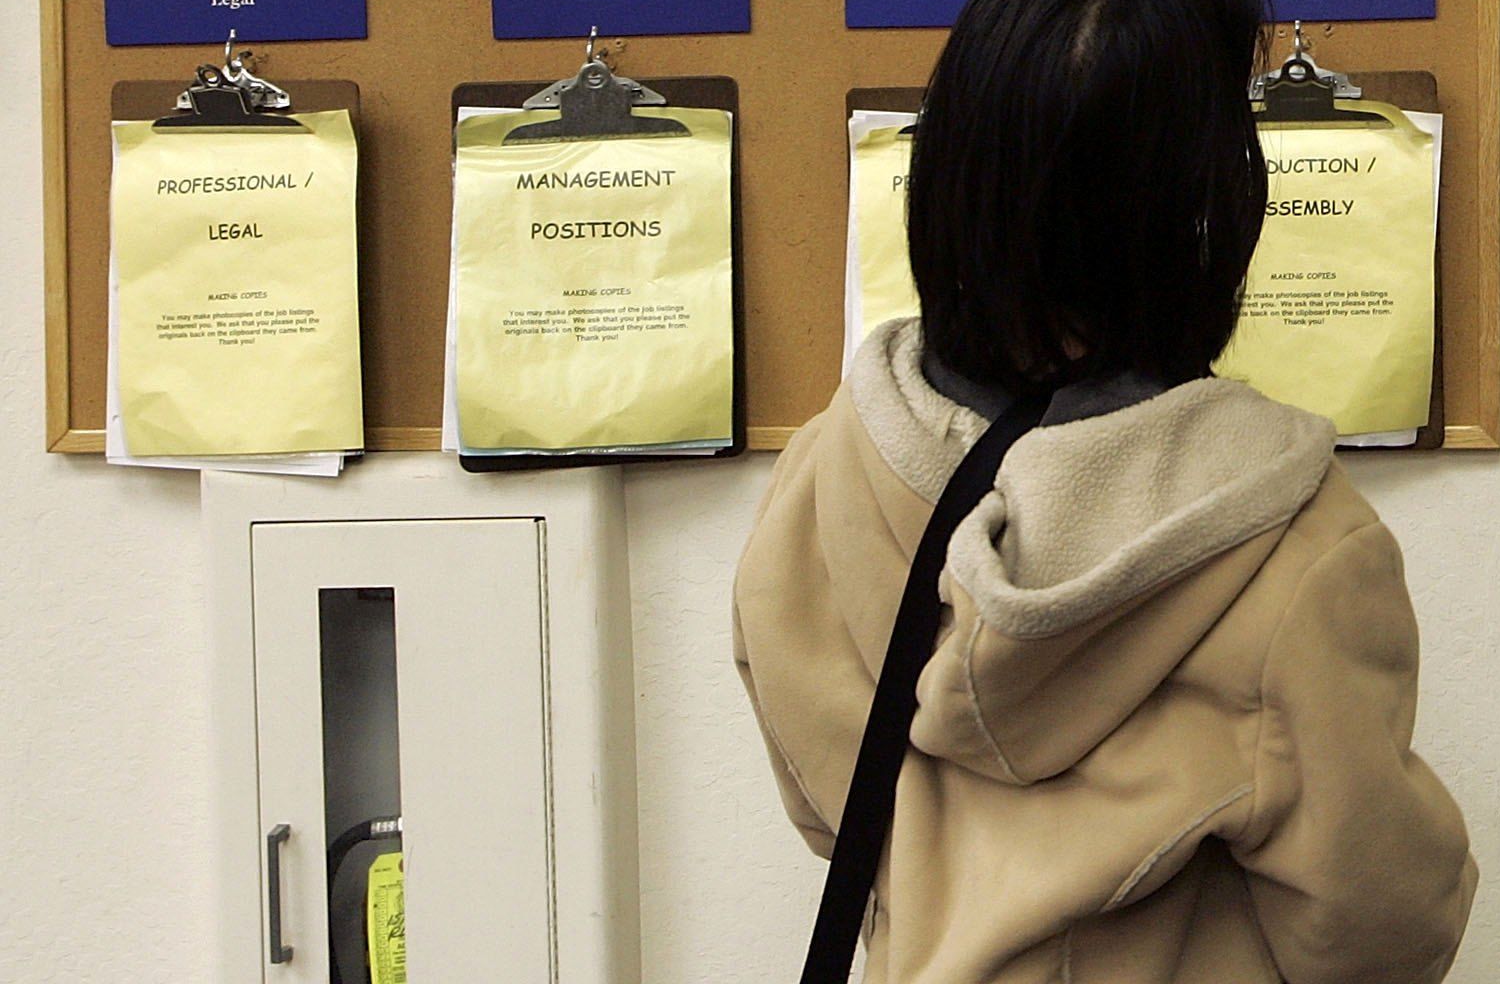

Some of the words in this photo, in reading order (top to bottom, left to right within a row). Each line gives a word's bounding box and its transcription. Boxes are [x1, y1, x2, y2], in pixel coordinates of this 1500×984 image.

[1266, 157, 1358, 174] DUCTION
[157, 173, 296, 194] PROFESSIONAL
[516, 169, 675, 190] MANAGEMENT
[1265, 199, 1353, 216] SSEMBLY
[208, 222, 263, 240] LEGAL
[531, 220, 661, 239] POSITIONS
[1270, 272, 1303, 280] MAKING
[1306, 271, 1336, 280] COPIES
[562, 288, 597, 296] MAKING
[600, 287, 631, 296] COPIES
[504, 327, 539, 336] originals
[540, 326, 559, 334] back
[573, 325, 586, 333] the
[588, 324, 624, 332] clipboard
